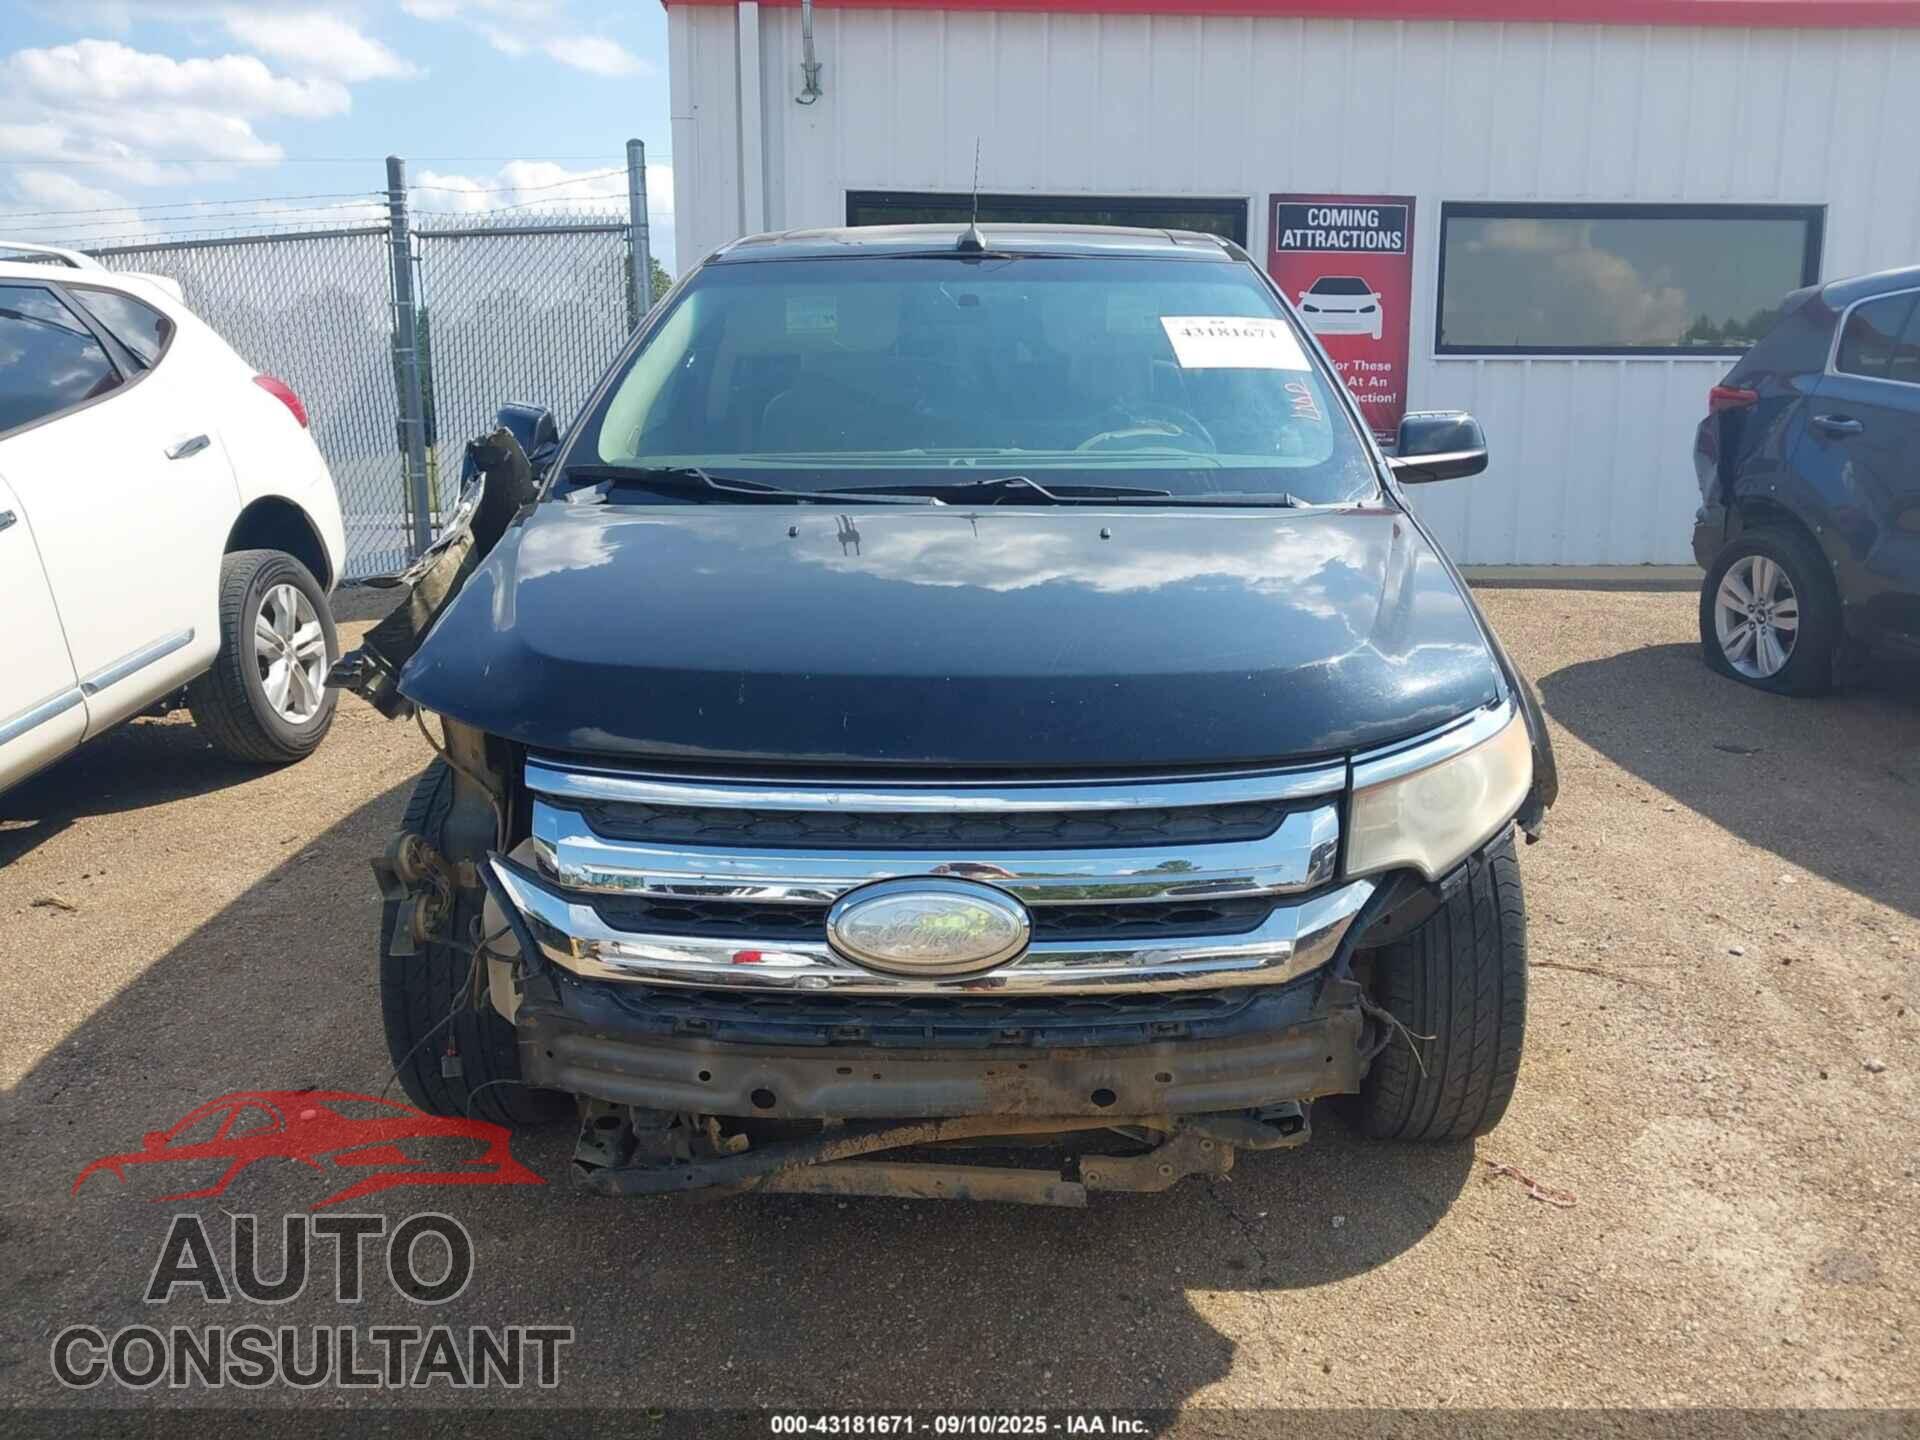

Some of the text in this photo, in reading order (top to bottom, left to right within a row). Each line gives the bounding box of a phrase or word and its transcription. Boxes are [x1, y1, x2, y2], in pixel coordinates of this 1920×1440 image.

[1307, 208, 1379, 228] COMING
[1281, 229, 1402, 249] ATTRACTIONS
[1352, 359, 1392, 371] These
[1347, 376, 1388, 387] At An
